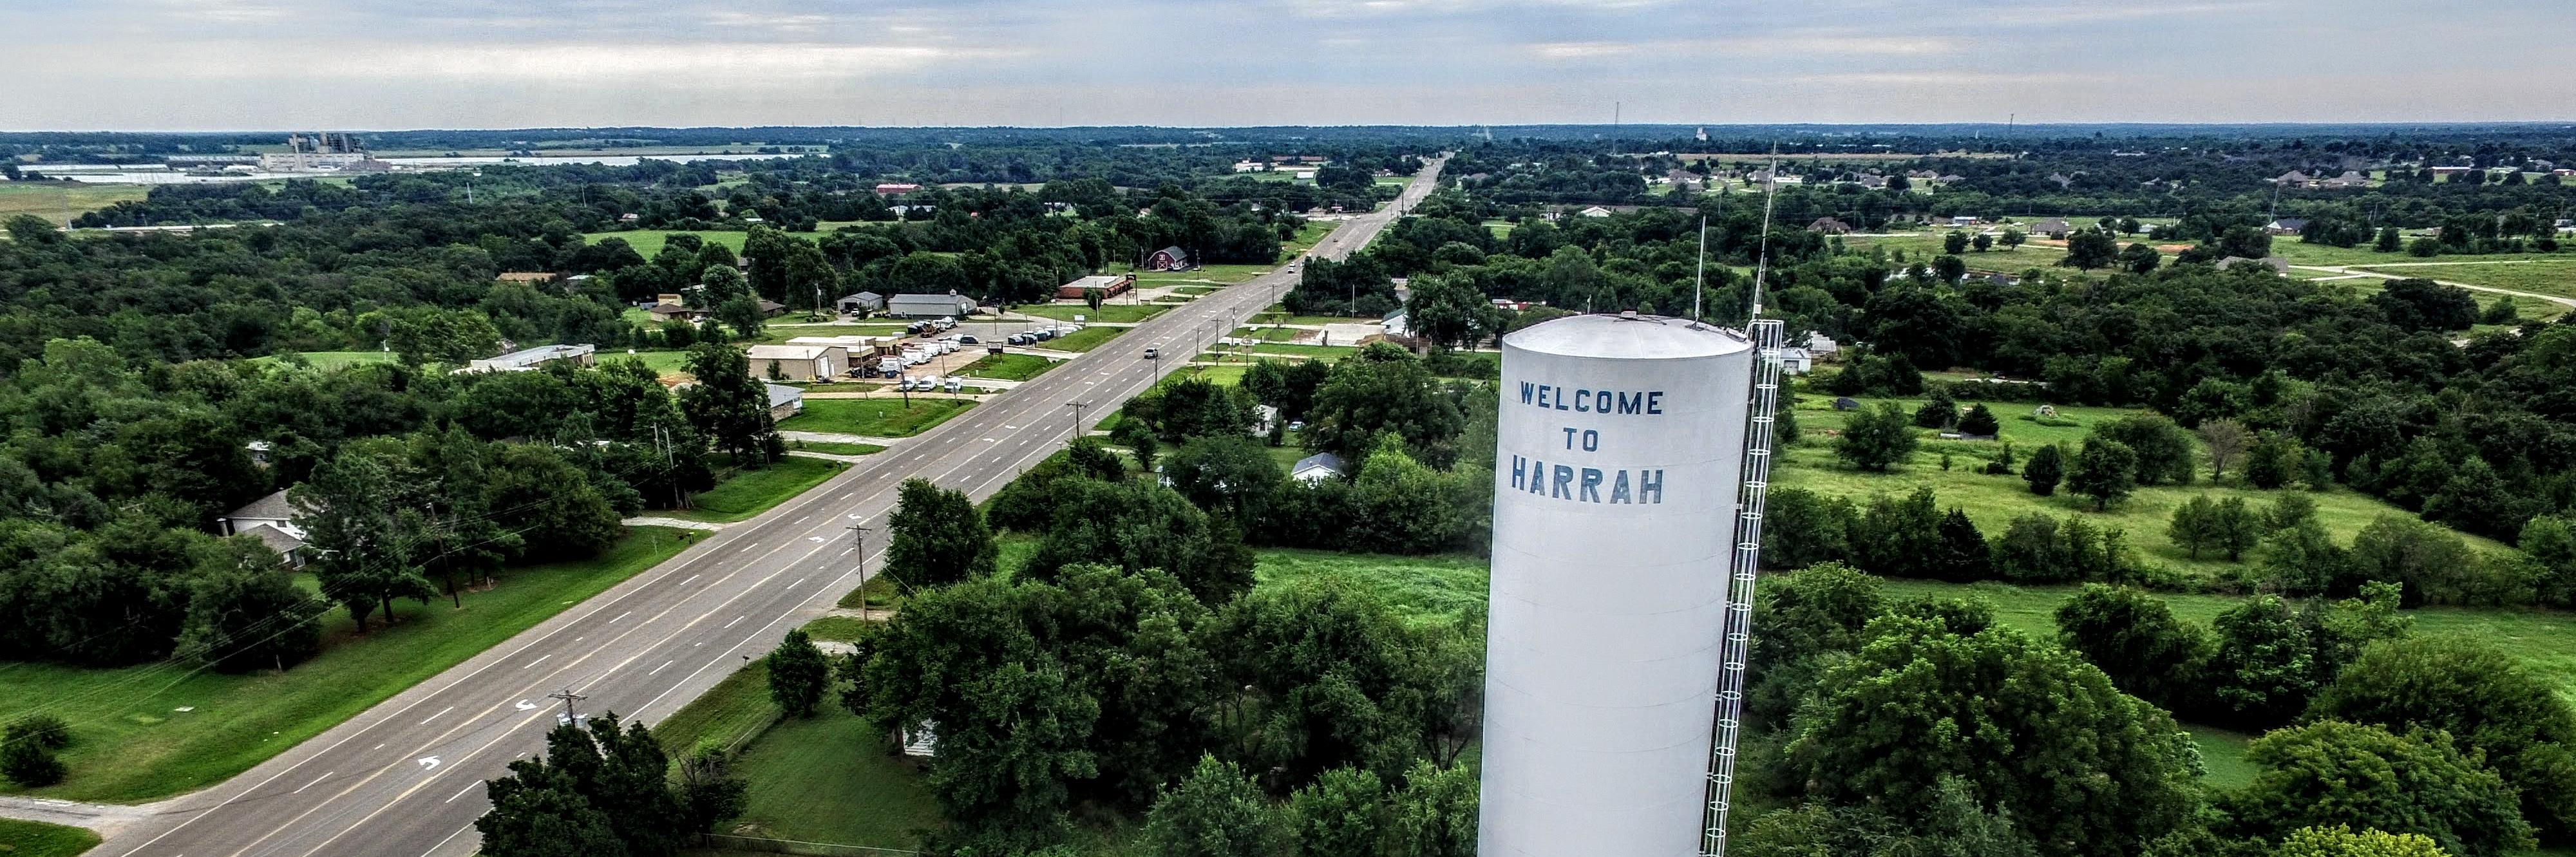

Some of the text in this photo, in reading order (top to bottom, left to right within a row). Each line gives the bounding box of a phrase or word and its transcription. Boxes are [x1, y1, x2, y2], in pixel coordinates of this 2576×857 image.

[1520, 381, 1663, 415] WELCOME
[1563, 428, 1598, 452] TO
[1511, 455, 1663, 504] HARRAH
